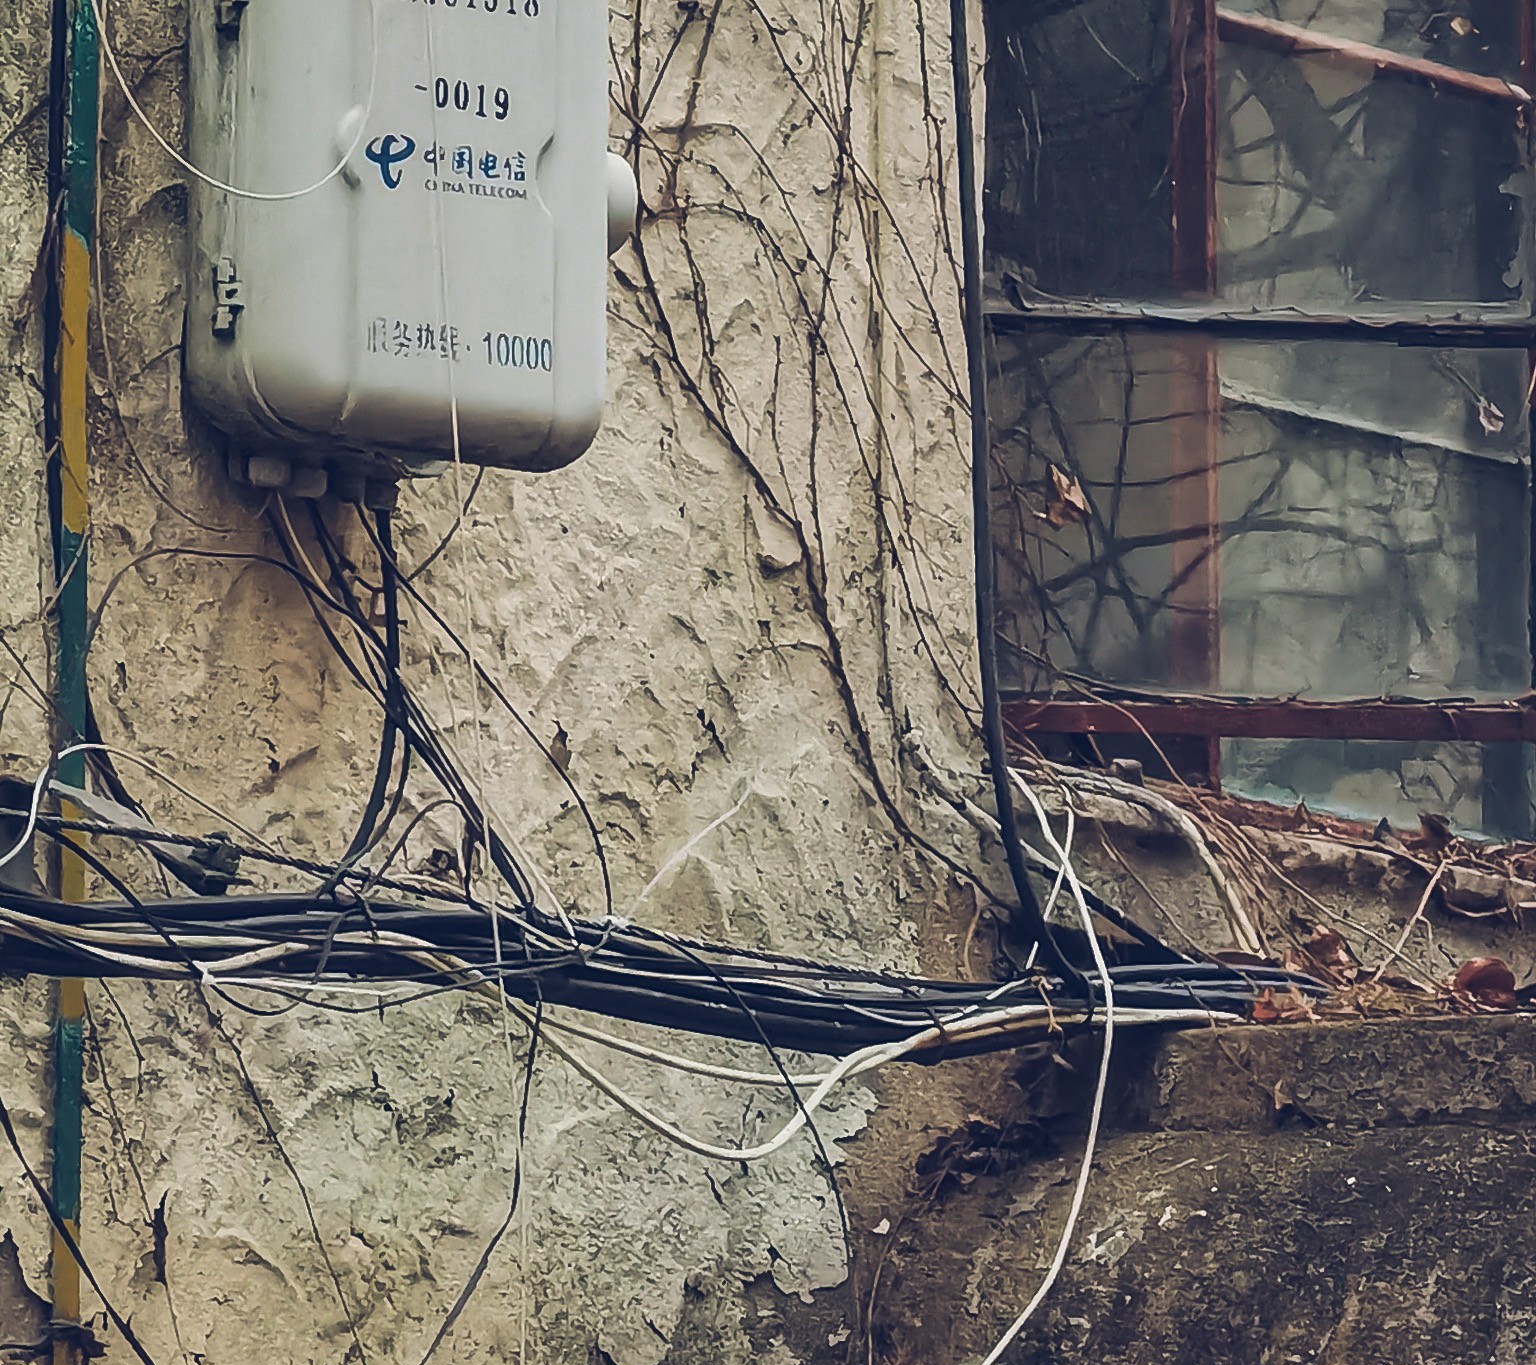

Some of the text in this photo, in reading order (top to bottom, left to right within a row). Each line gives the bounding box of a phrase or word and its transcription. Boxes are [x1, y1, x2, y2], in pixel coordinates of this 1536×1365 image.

[423, 139, 527, 182] 中国电信
[469, 182, 528, 200] TELECOM
